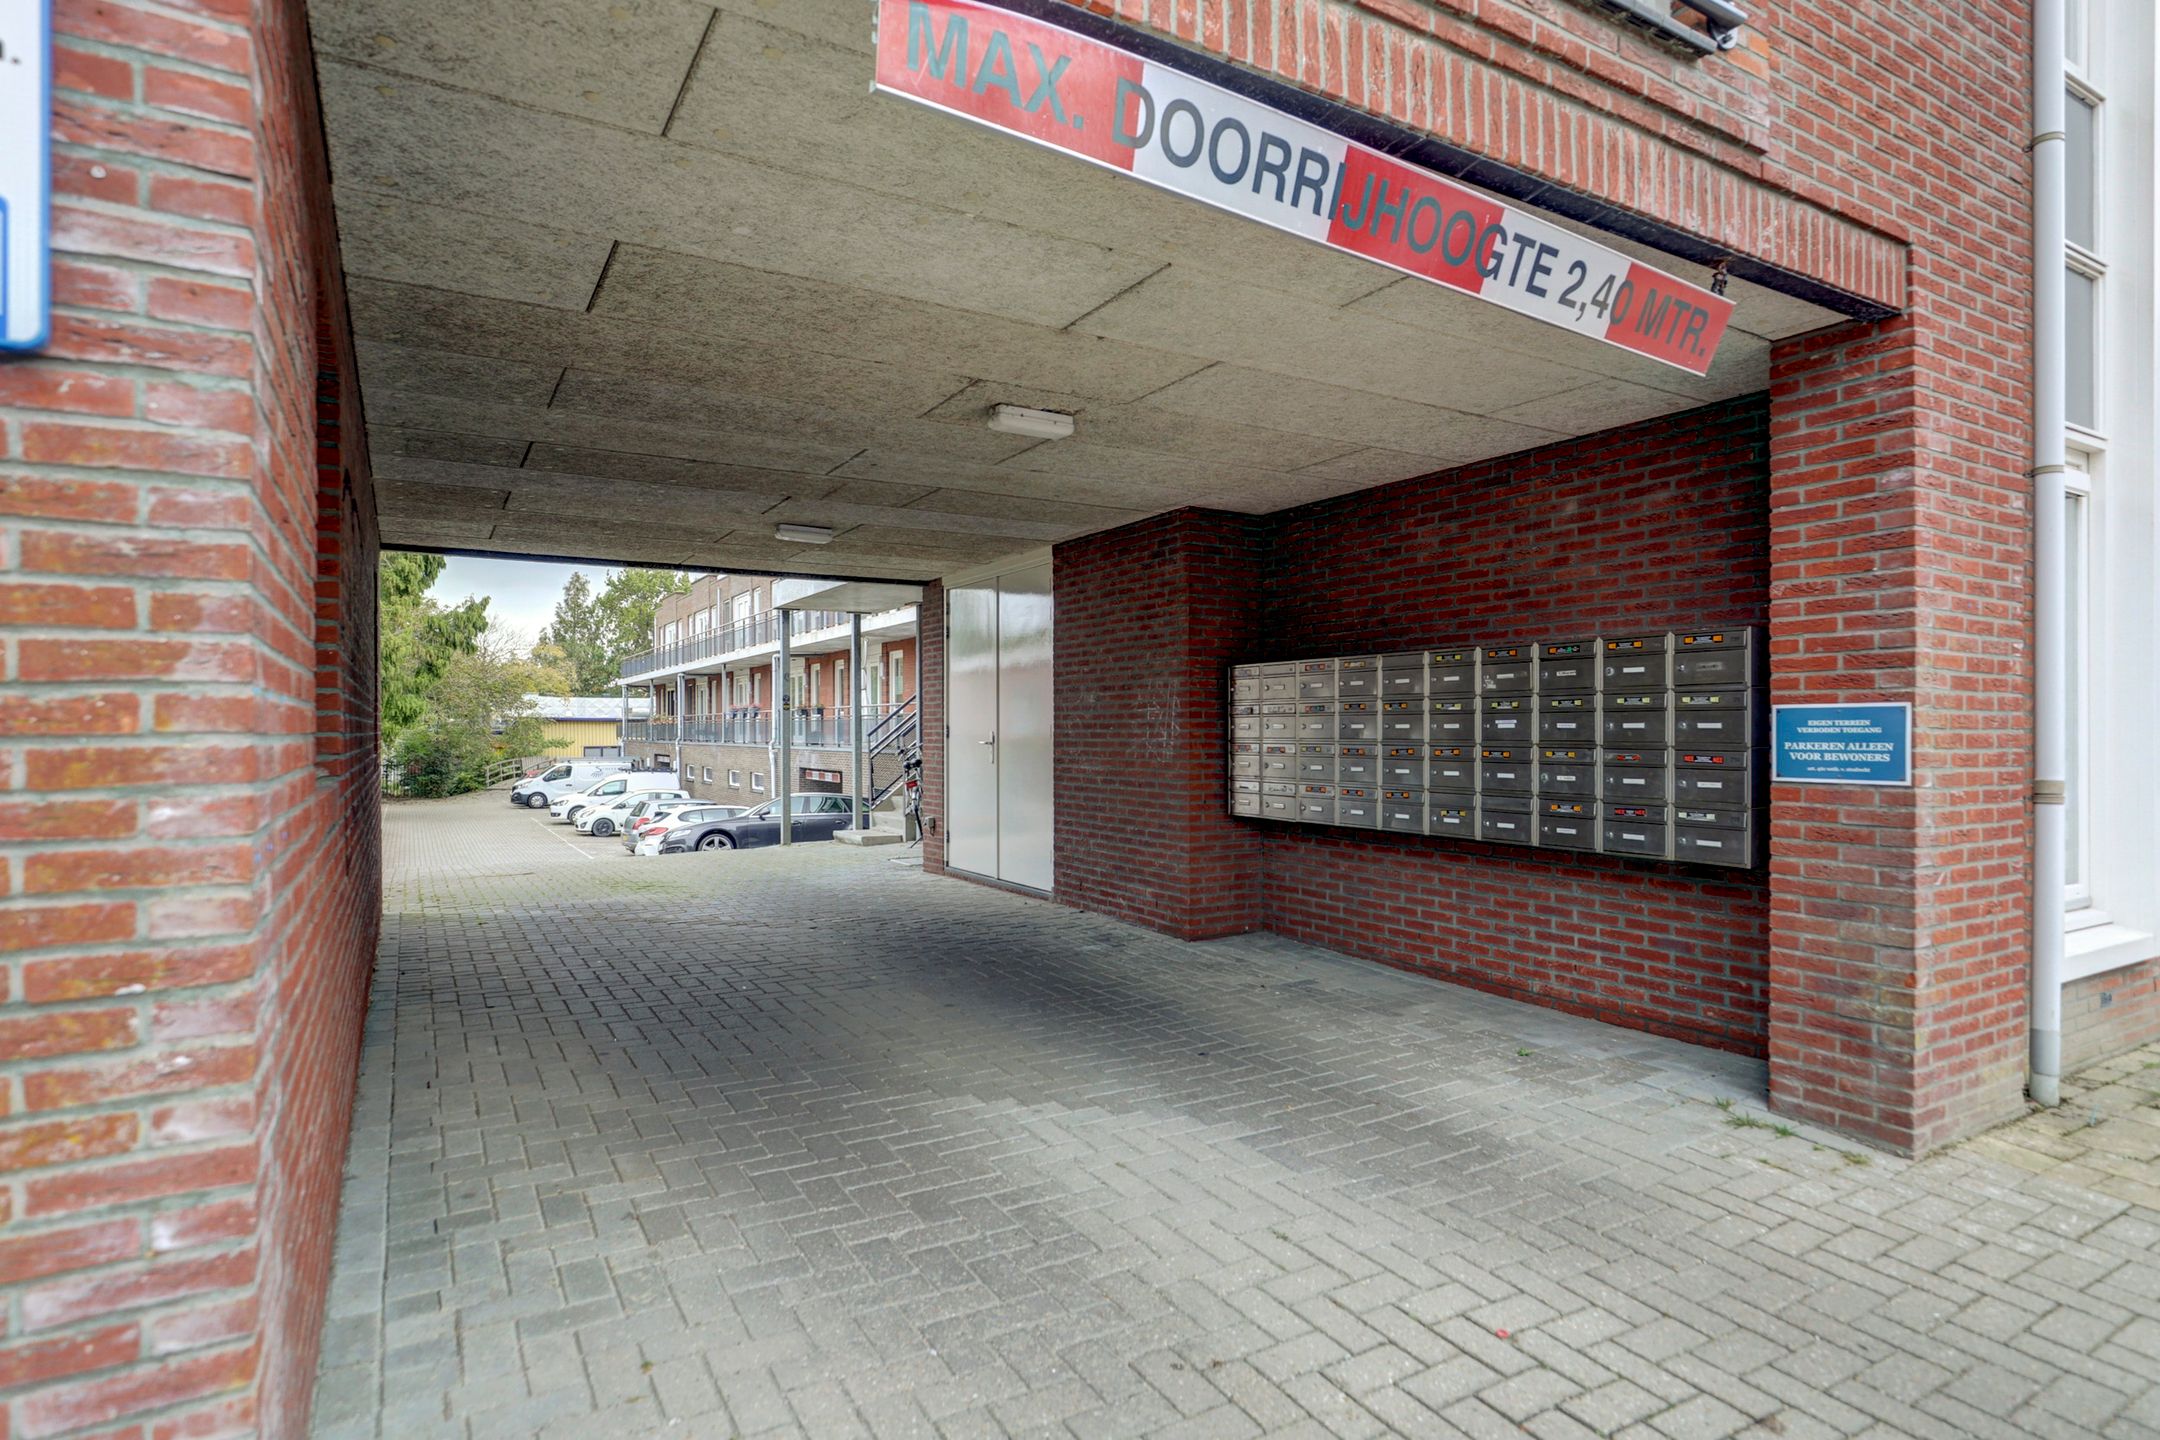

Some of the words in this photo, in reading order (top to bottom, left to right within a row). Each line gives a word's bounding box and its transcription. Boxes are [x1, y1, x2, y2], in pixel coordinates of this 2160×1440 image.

[907, 1, 1085, 130] MAX.
[1111, 76, 1560, 298] DOORRIJHOOGTE
[1558, 260, 1633, 326] 2,40
[1635, 288, 1707, 358] MTR.
[1784, 742, 1845, 750] PARKEREN
[1847, 742, 1894, 751] ALLEEN
[1789, 752, 1822, 760] VOOR
[1824, 752, 1890, 762] BEWONERS
